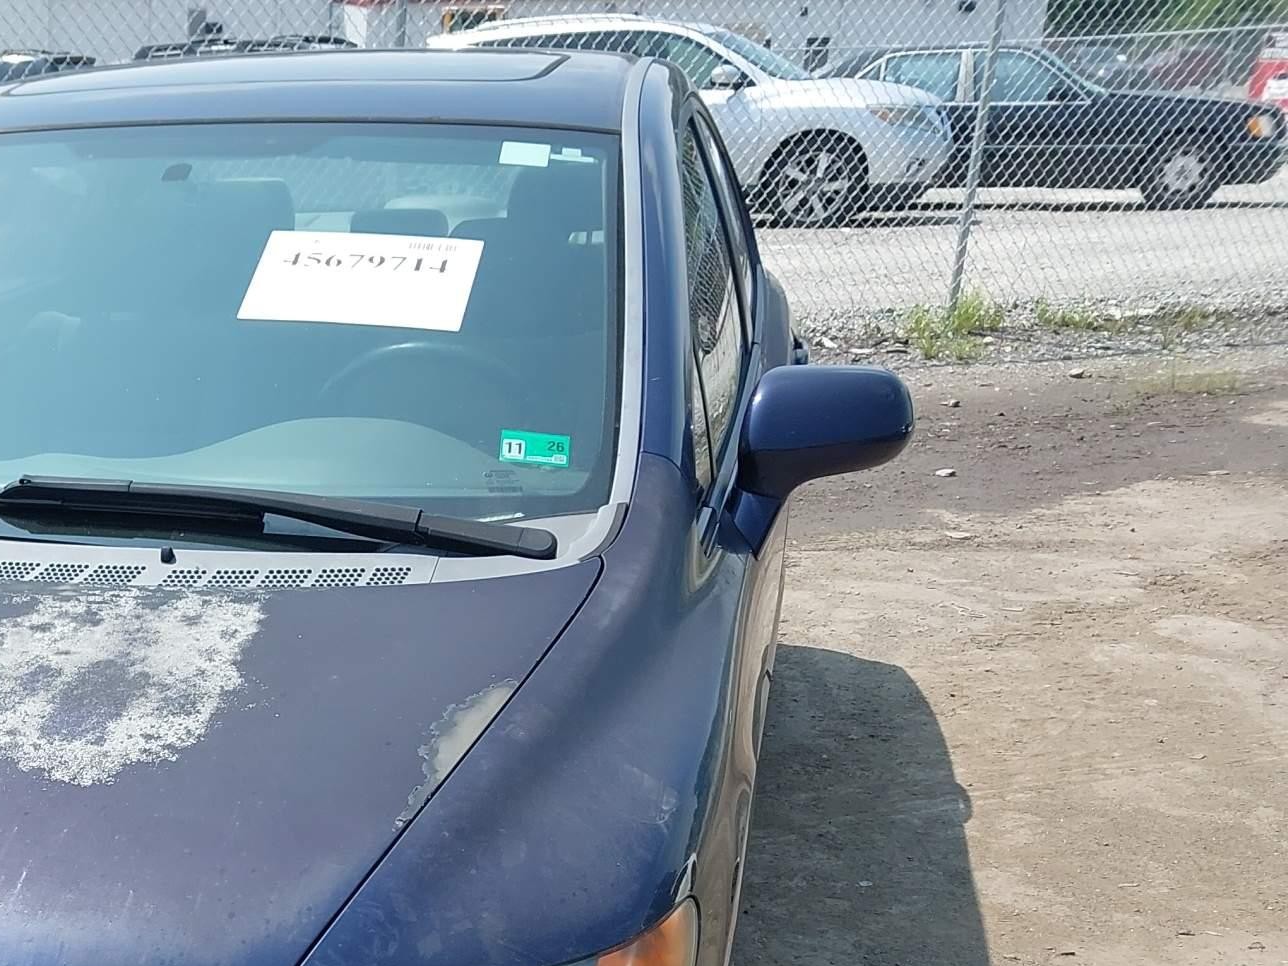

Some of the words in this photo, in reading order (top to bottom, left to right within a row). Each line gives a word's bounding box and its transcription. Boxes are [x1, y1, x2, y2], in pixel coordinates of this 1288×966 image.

[283, 252, 448, 273] 45679714
[504, 441, 523, 455] 11
[547, 441, 565, 453] 26
